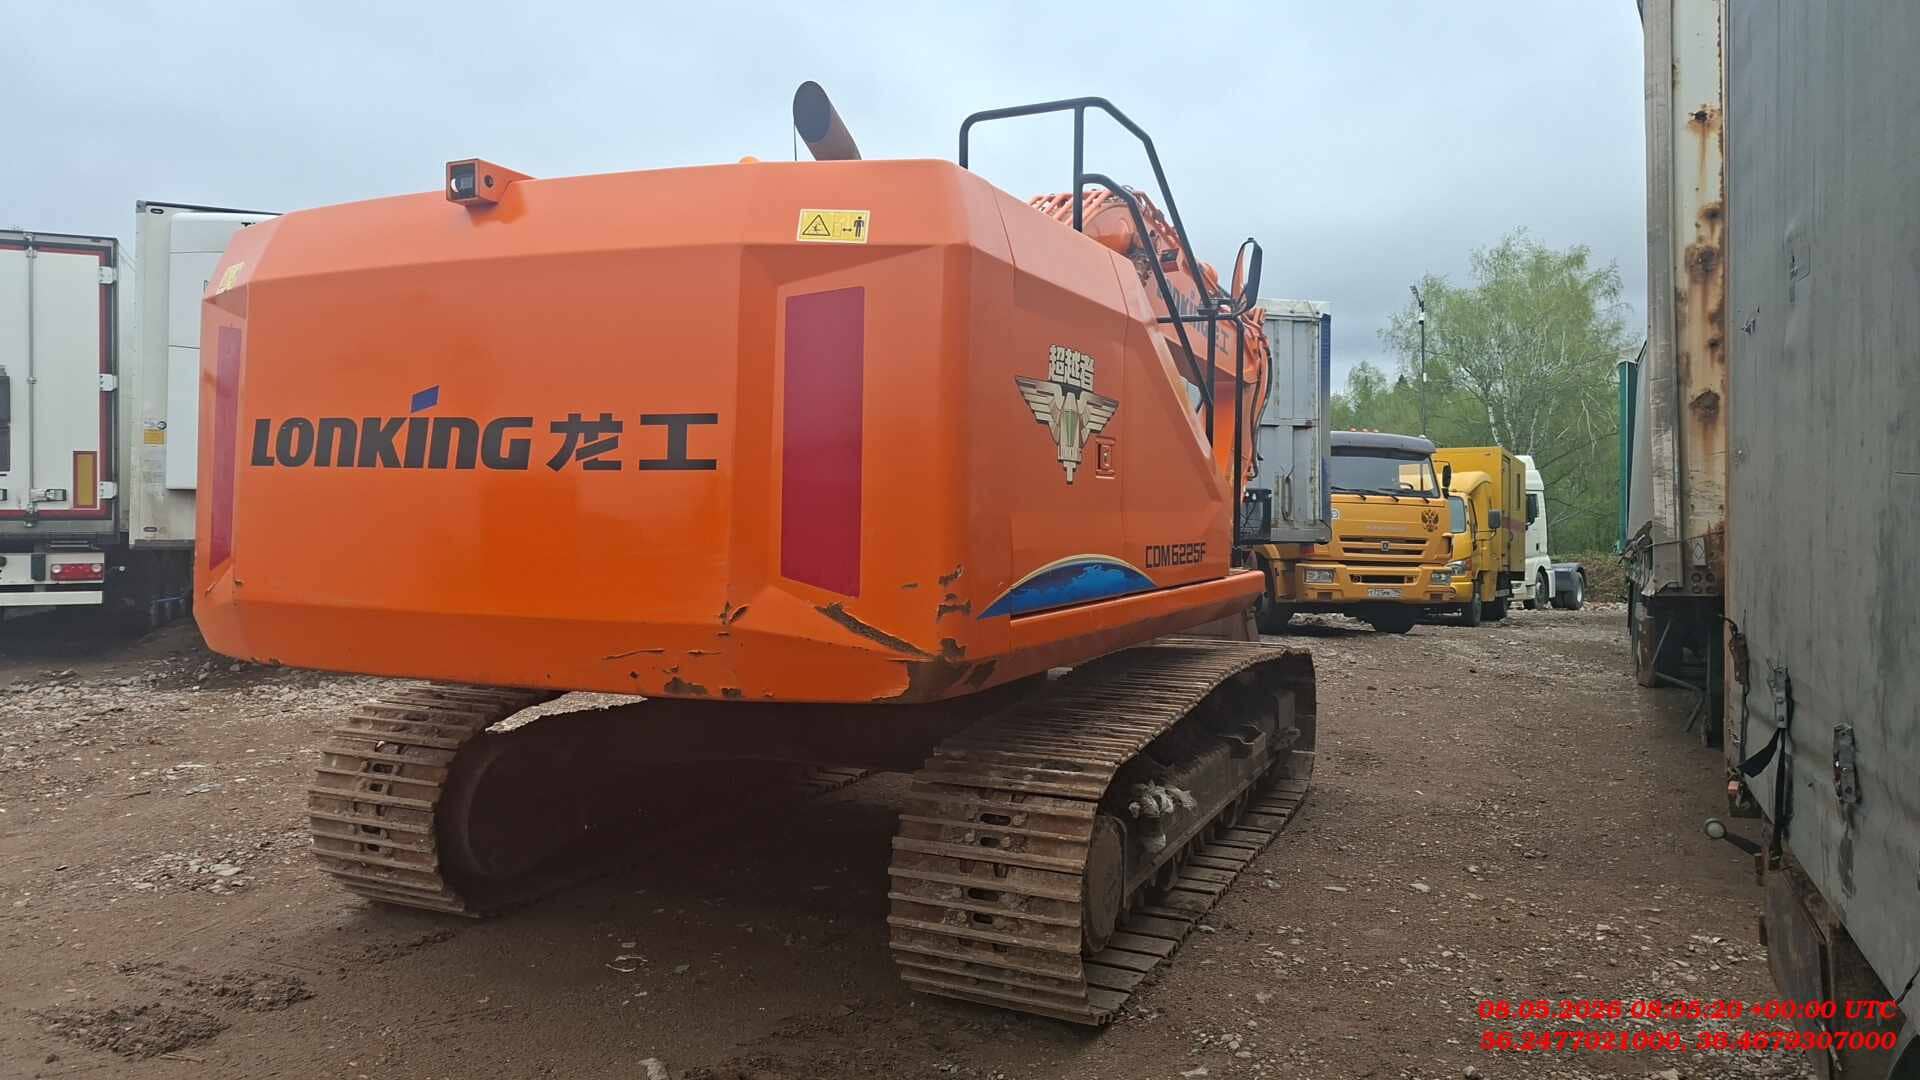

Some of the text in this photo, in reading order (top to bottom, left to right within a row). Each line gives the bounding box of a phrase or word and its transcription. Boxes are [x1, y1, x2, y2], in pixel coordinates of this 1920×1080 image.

[1048, 344, 1095, 392] 超越者
[545, 412, 719, 472] 龙工
[1145, 542, 1206, 568] CDM6225F
